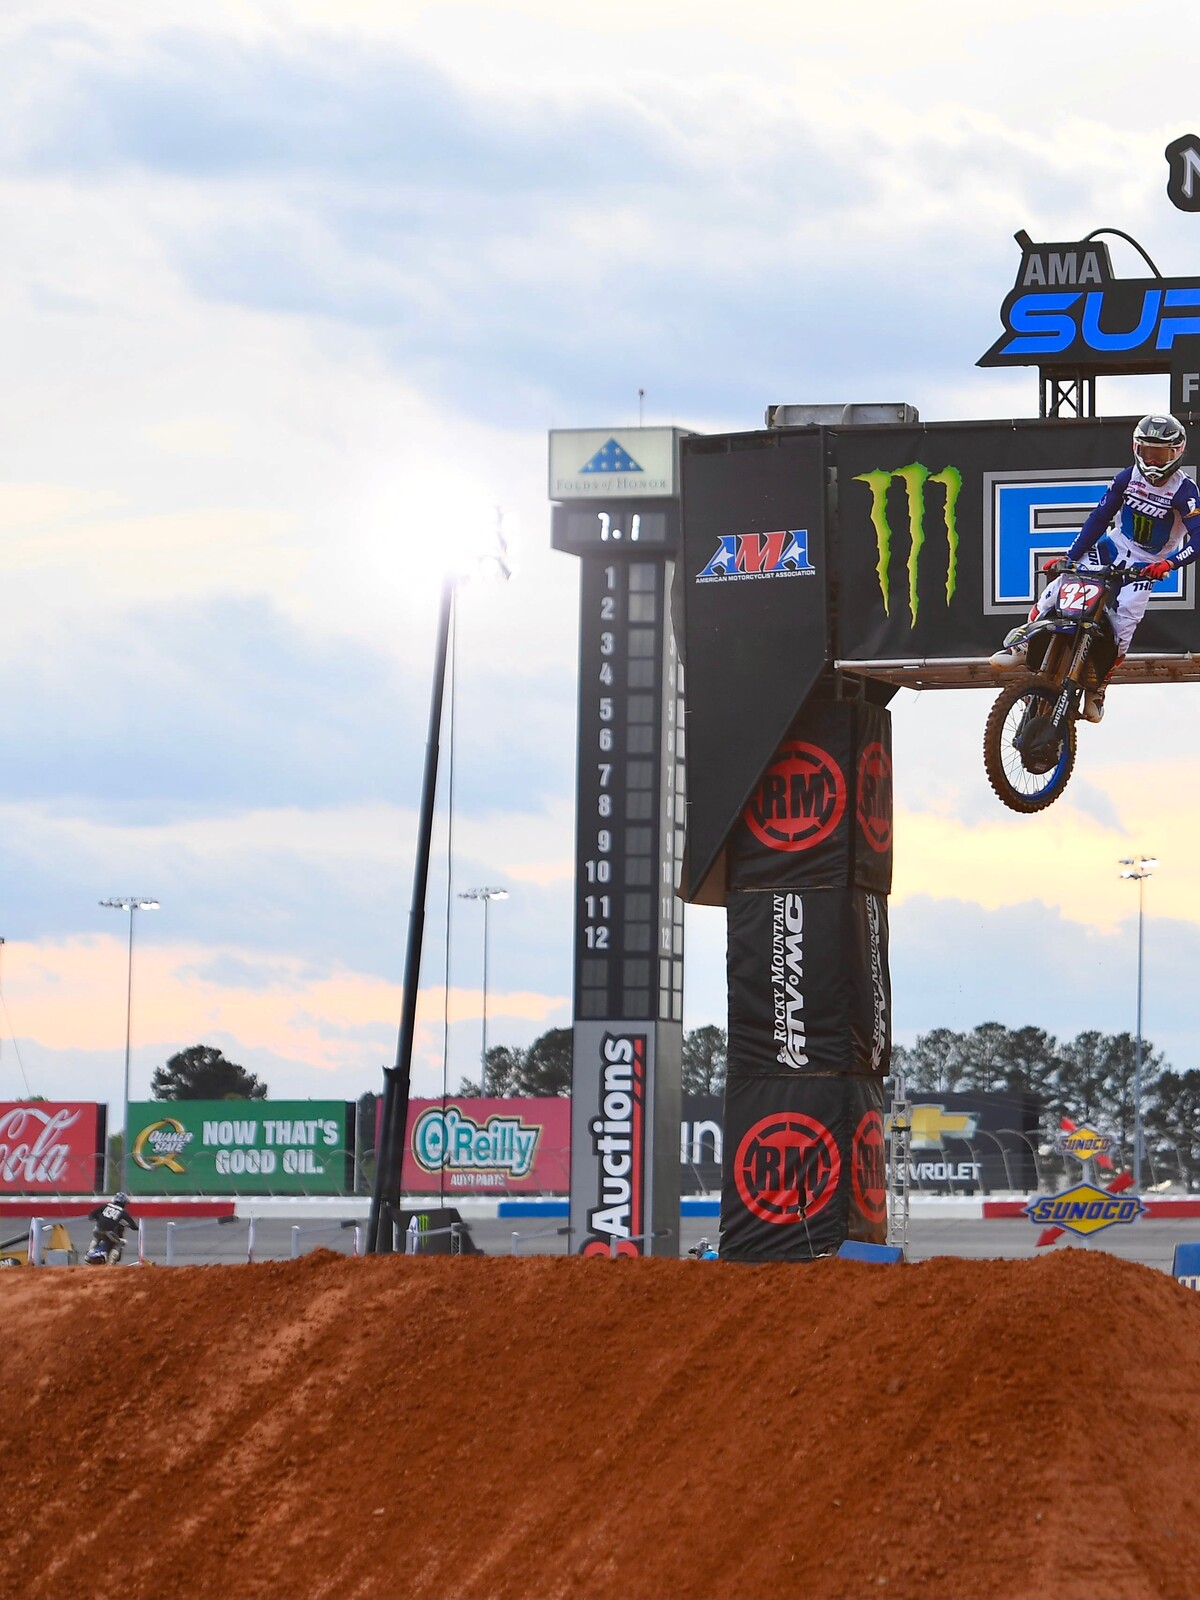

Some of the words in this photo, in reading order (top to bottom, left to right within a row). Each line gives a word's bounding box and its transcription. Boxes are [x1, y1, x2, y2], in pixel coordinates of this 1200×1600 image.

[1022, 251, 1102, 286] AMA
[556, 479, 598, 490] FOLDS
[617, 477, 667, 490] HONOR
[1126, 496, 1167, 518] THOR
[695, 529, 815, 577] AMA
[604, 566, 614, 589] 1
[695, 576, 727, 584] AMERICAN
[728, 573, 774, 581] MOTORCYCLIST
[775, 569, 816, 578] ASSOCIATION
[601, 597, 613, 619] 2
[1060, 583, 1099, 610] 32
[601, 632, 613, 655] 3
[600, 662, 612, 686] 4
[600, 698, 612, 721] 5
[1053, 689, 1068, 727] DUNLOP
[600, 728, 612, 750] 6
[598, 764, 611, 787] 7
[598, 794, 611, 817] 8
[763, 773, 825, 819] RM
[598, 829, 611, 852] 9
[585, 860, 611, 883] 10
[585, 895, 610, 918] 11
[585, 926, 609, 949] 12
[771, 893, 785, 986] MOUNTAIN
[773, 988, 787, 1043] ROCKY
[148, 1130, 194, 1143] QUAKER
[202, 1120, 257, 1146] NOW
[263, 1118, 338, 1146] THAT'S
[416, 1111, 535, 1172] O'Reilly
[592, 1038, 634, 1238] Auctions
[152, 1142, 187, 1153] STATE
[1058, 1138, 1111, 1150] SUNOCO
[215, 1149, 276, 1174] GOOD
[283, 1149, 324, 1174] OIL.
[755, 1145, 822, 1192] RM
[451, 1174, 474, 1187] AUTO
[476, 1174, 506, 1187] PARTS
[1037, 1201, 1136, 1220] SUNOCO
